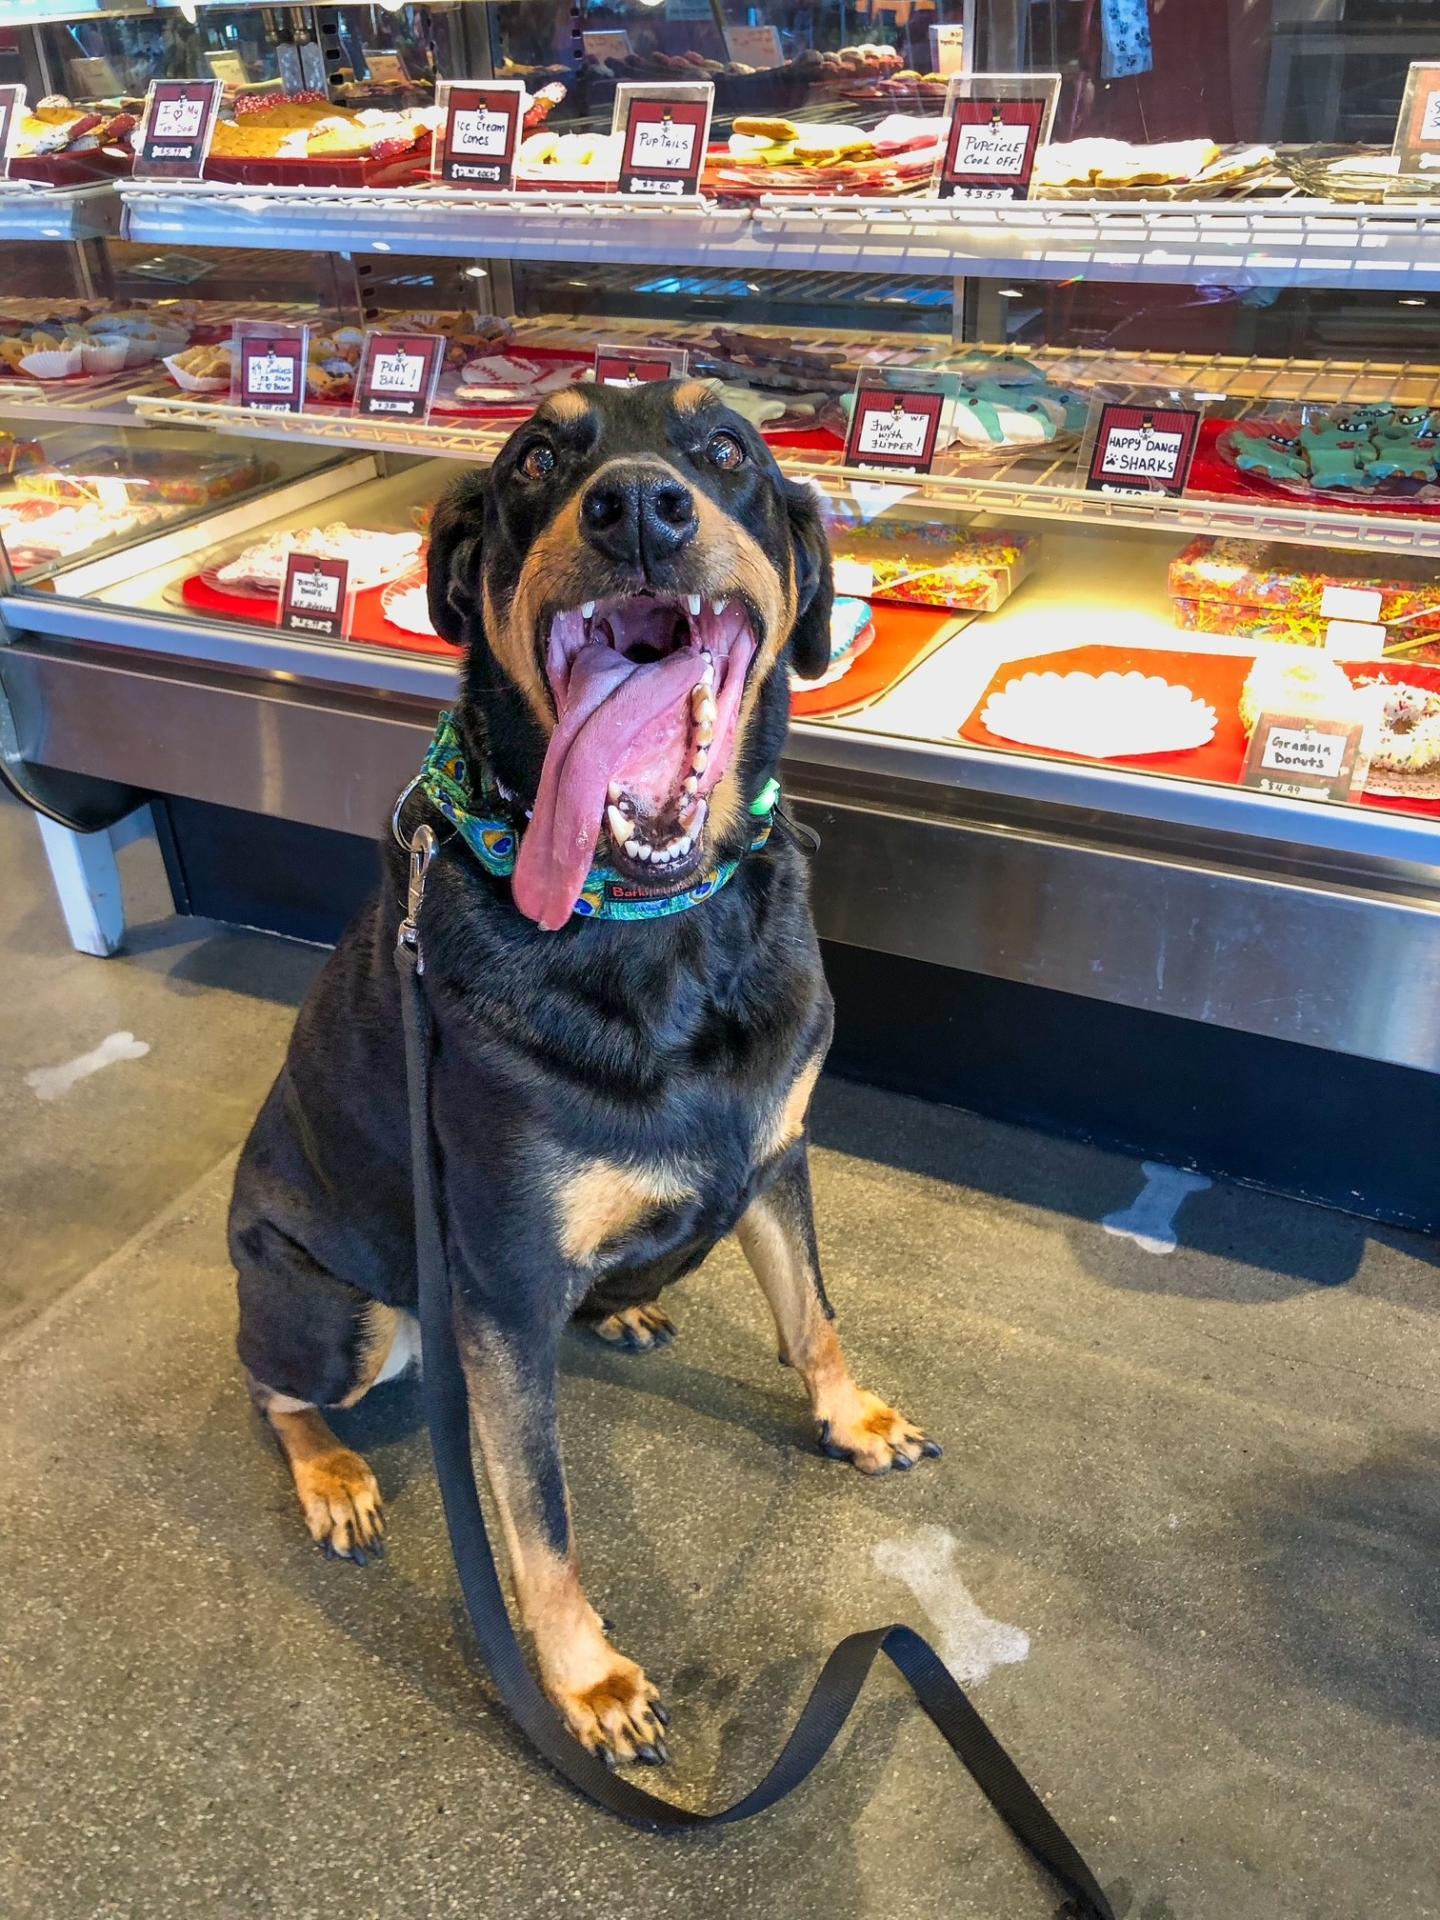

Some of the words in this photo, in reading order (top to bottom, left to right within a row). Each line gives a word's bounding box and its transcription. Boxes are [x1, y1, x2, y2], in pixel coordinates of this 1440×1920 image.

[457, 120, 471, 131] Ice
[476, 121, 506, 133] Cream
[462, 133, 489, 146] Cones
[380, 361, 408, 373] PLAY
[1109, 437, 1141, 452] HAPPY
[1146, 440, 1180, 454] DANCE
[1119, 454, 1175, 473] SHARKS
[1272, 736, 1331, 756] Granola
[1274, 752, 1325, 769] Donuts
